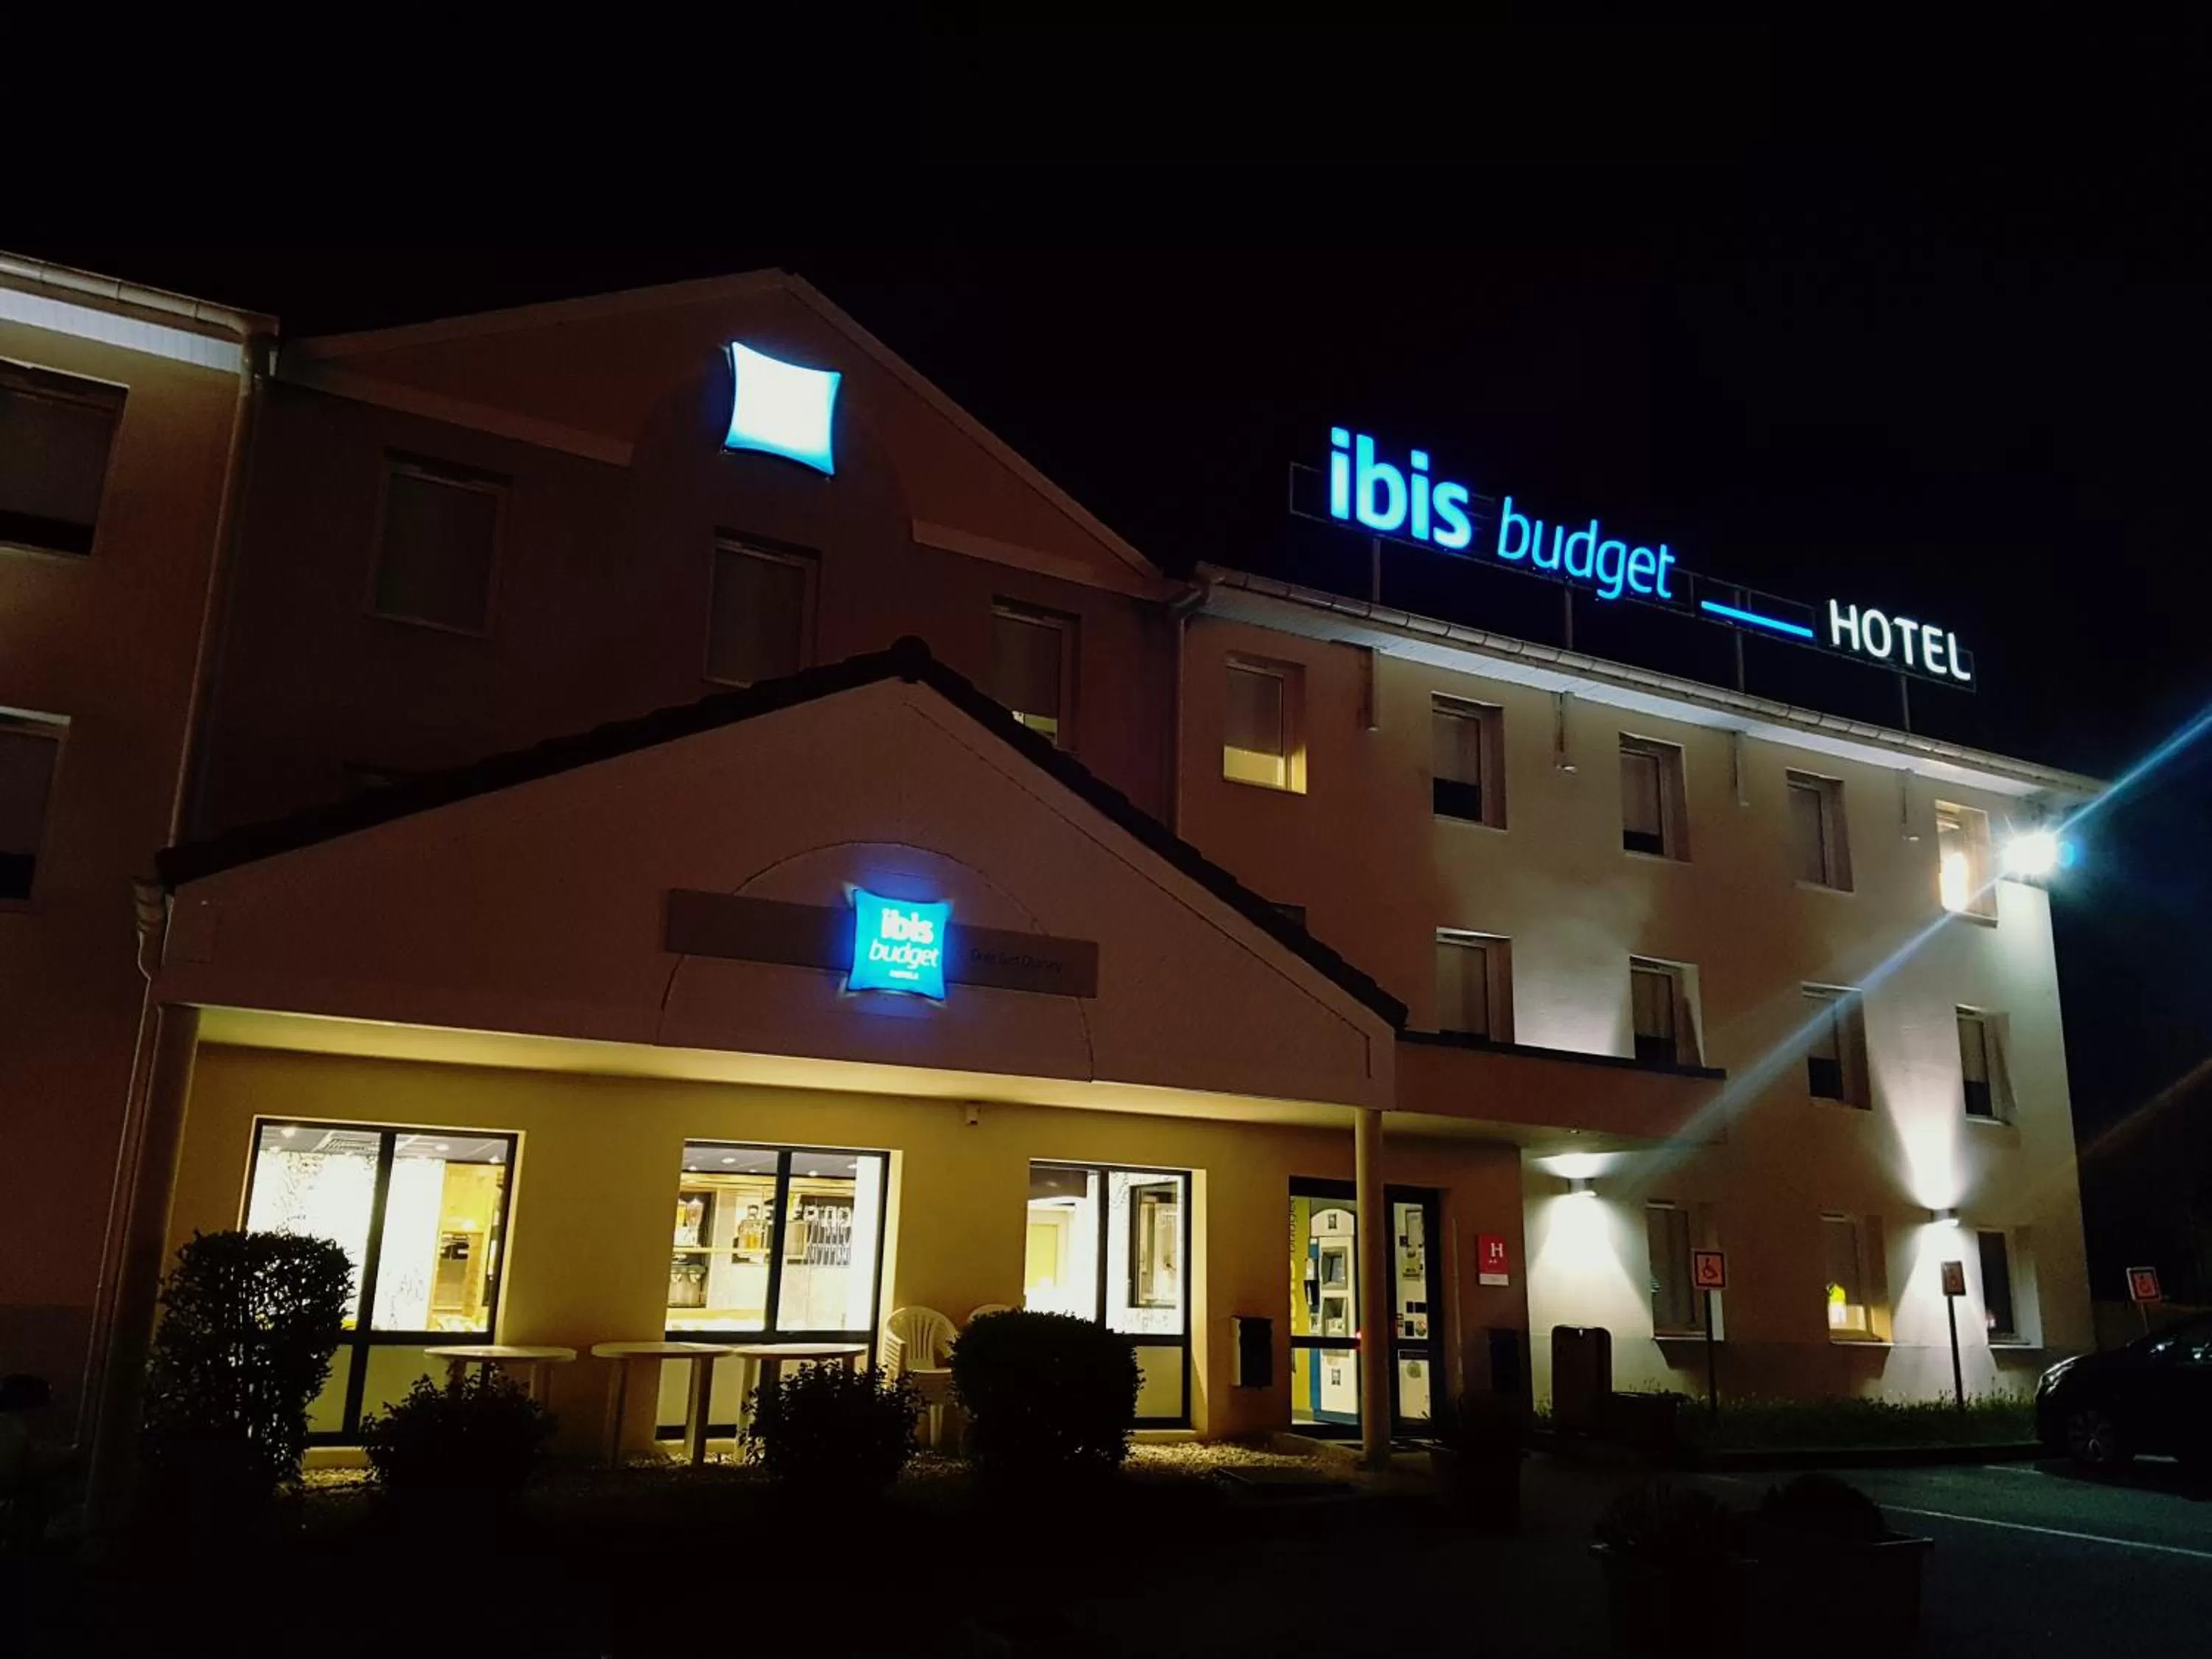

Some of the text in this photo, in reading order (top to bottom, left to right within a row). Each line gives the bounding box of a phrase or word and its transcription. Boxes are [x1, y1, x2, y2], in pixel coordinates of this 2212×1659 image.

[1330, 426, 1676, 600] ibis budget
[1829, 598, 1972, 681] HOTEL
[881, 908, 933, 944] ibis
[869, 939, 939, 970] budget
[1490, 1242, 1504, 1259] H
